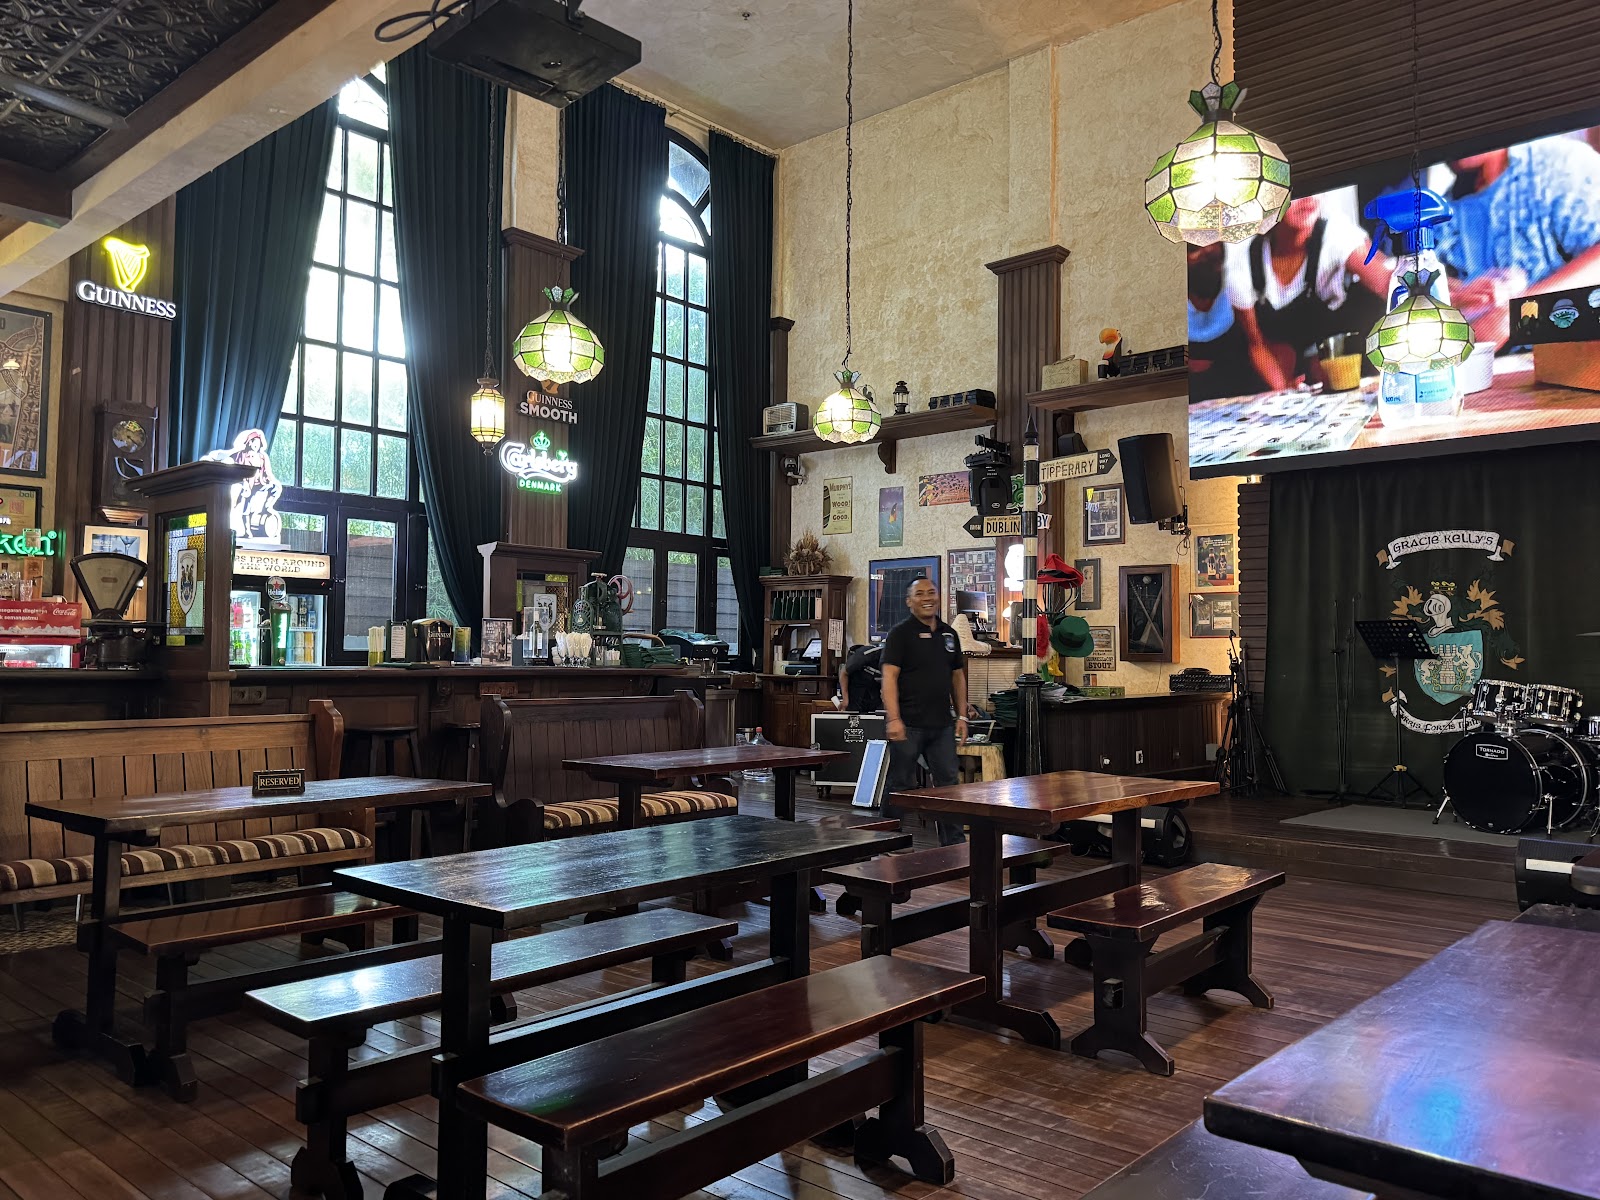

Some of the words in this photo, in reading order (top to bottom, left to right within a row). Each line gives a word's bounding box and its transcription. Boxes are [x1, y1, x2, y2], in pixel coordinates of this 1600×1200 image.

[78, 281, 177, 319] GUINNESS
[526, 390, 573, 410] GUINNESS
[519, 401, 578, 425] SMOOTH
[500, 440, 579, 484] Carlsberg
[1041, 459, 1094, 480] TIPPERARY
[519, 479, 562, 493] DENMARK
[19, 490, 35, 499] bali
[832, 500, 851, 508] WOOD!
[985, 521, 1021, 534] DUBLIN
[249, 556, 279, 566] FROM
[282, 558, 326, 569] AROUND
[264, 565, 302, 574] WORLD
[1478, 746, 1505, 755] TORNADO
[259, 776, 300, 787] RESERVED
